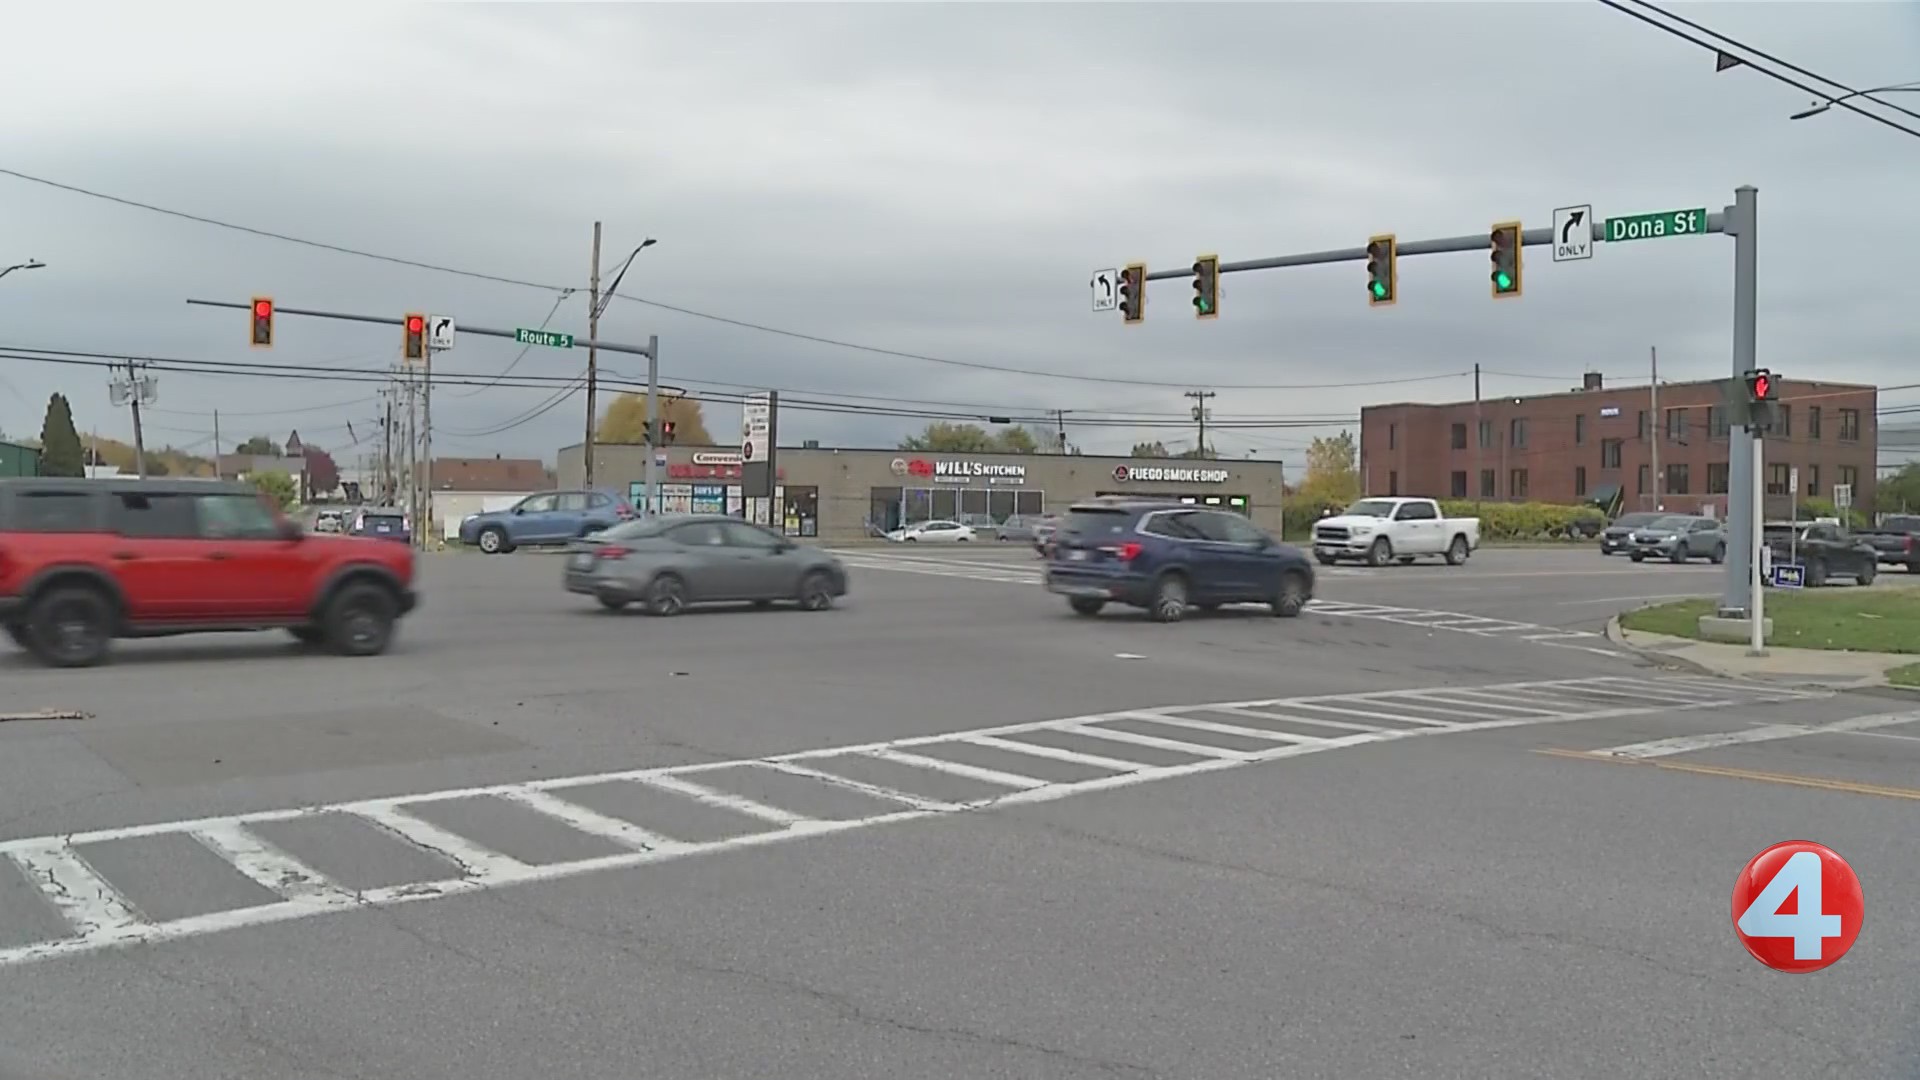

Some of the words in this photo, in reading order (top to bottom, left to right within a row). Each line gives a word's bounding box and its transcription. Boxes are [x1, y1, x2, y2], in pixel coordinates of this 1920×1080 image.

[1613, 218, 1665, 240] Dona
[1673, 212, 1697, 233] St
[1558, 244, 1586, 257] ONLY
[520, 330, 555, 345] Route
[560, 335, 569, 347] 5
[935, 461, 982, 475] WILL'S
[983, 465, 1025, 476] KITCHEN
[1129, 467, 1162, 480] FUEGO
[1163, 468, 1200, 481] SMOKE
[1200, 470, 1228, 482] SHOP
